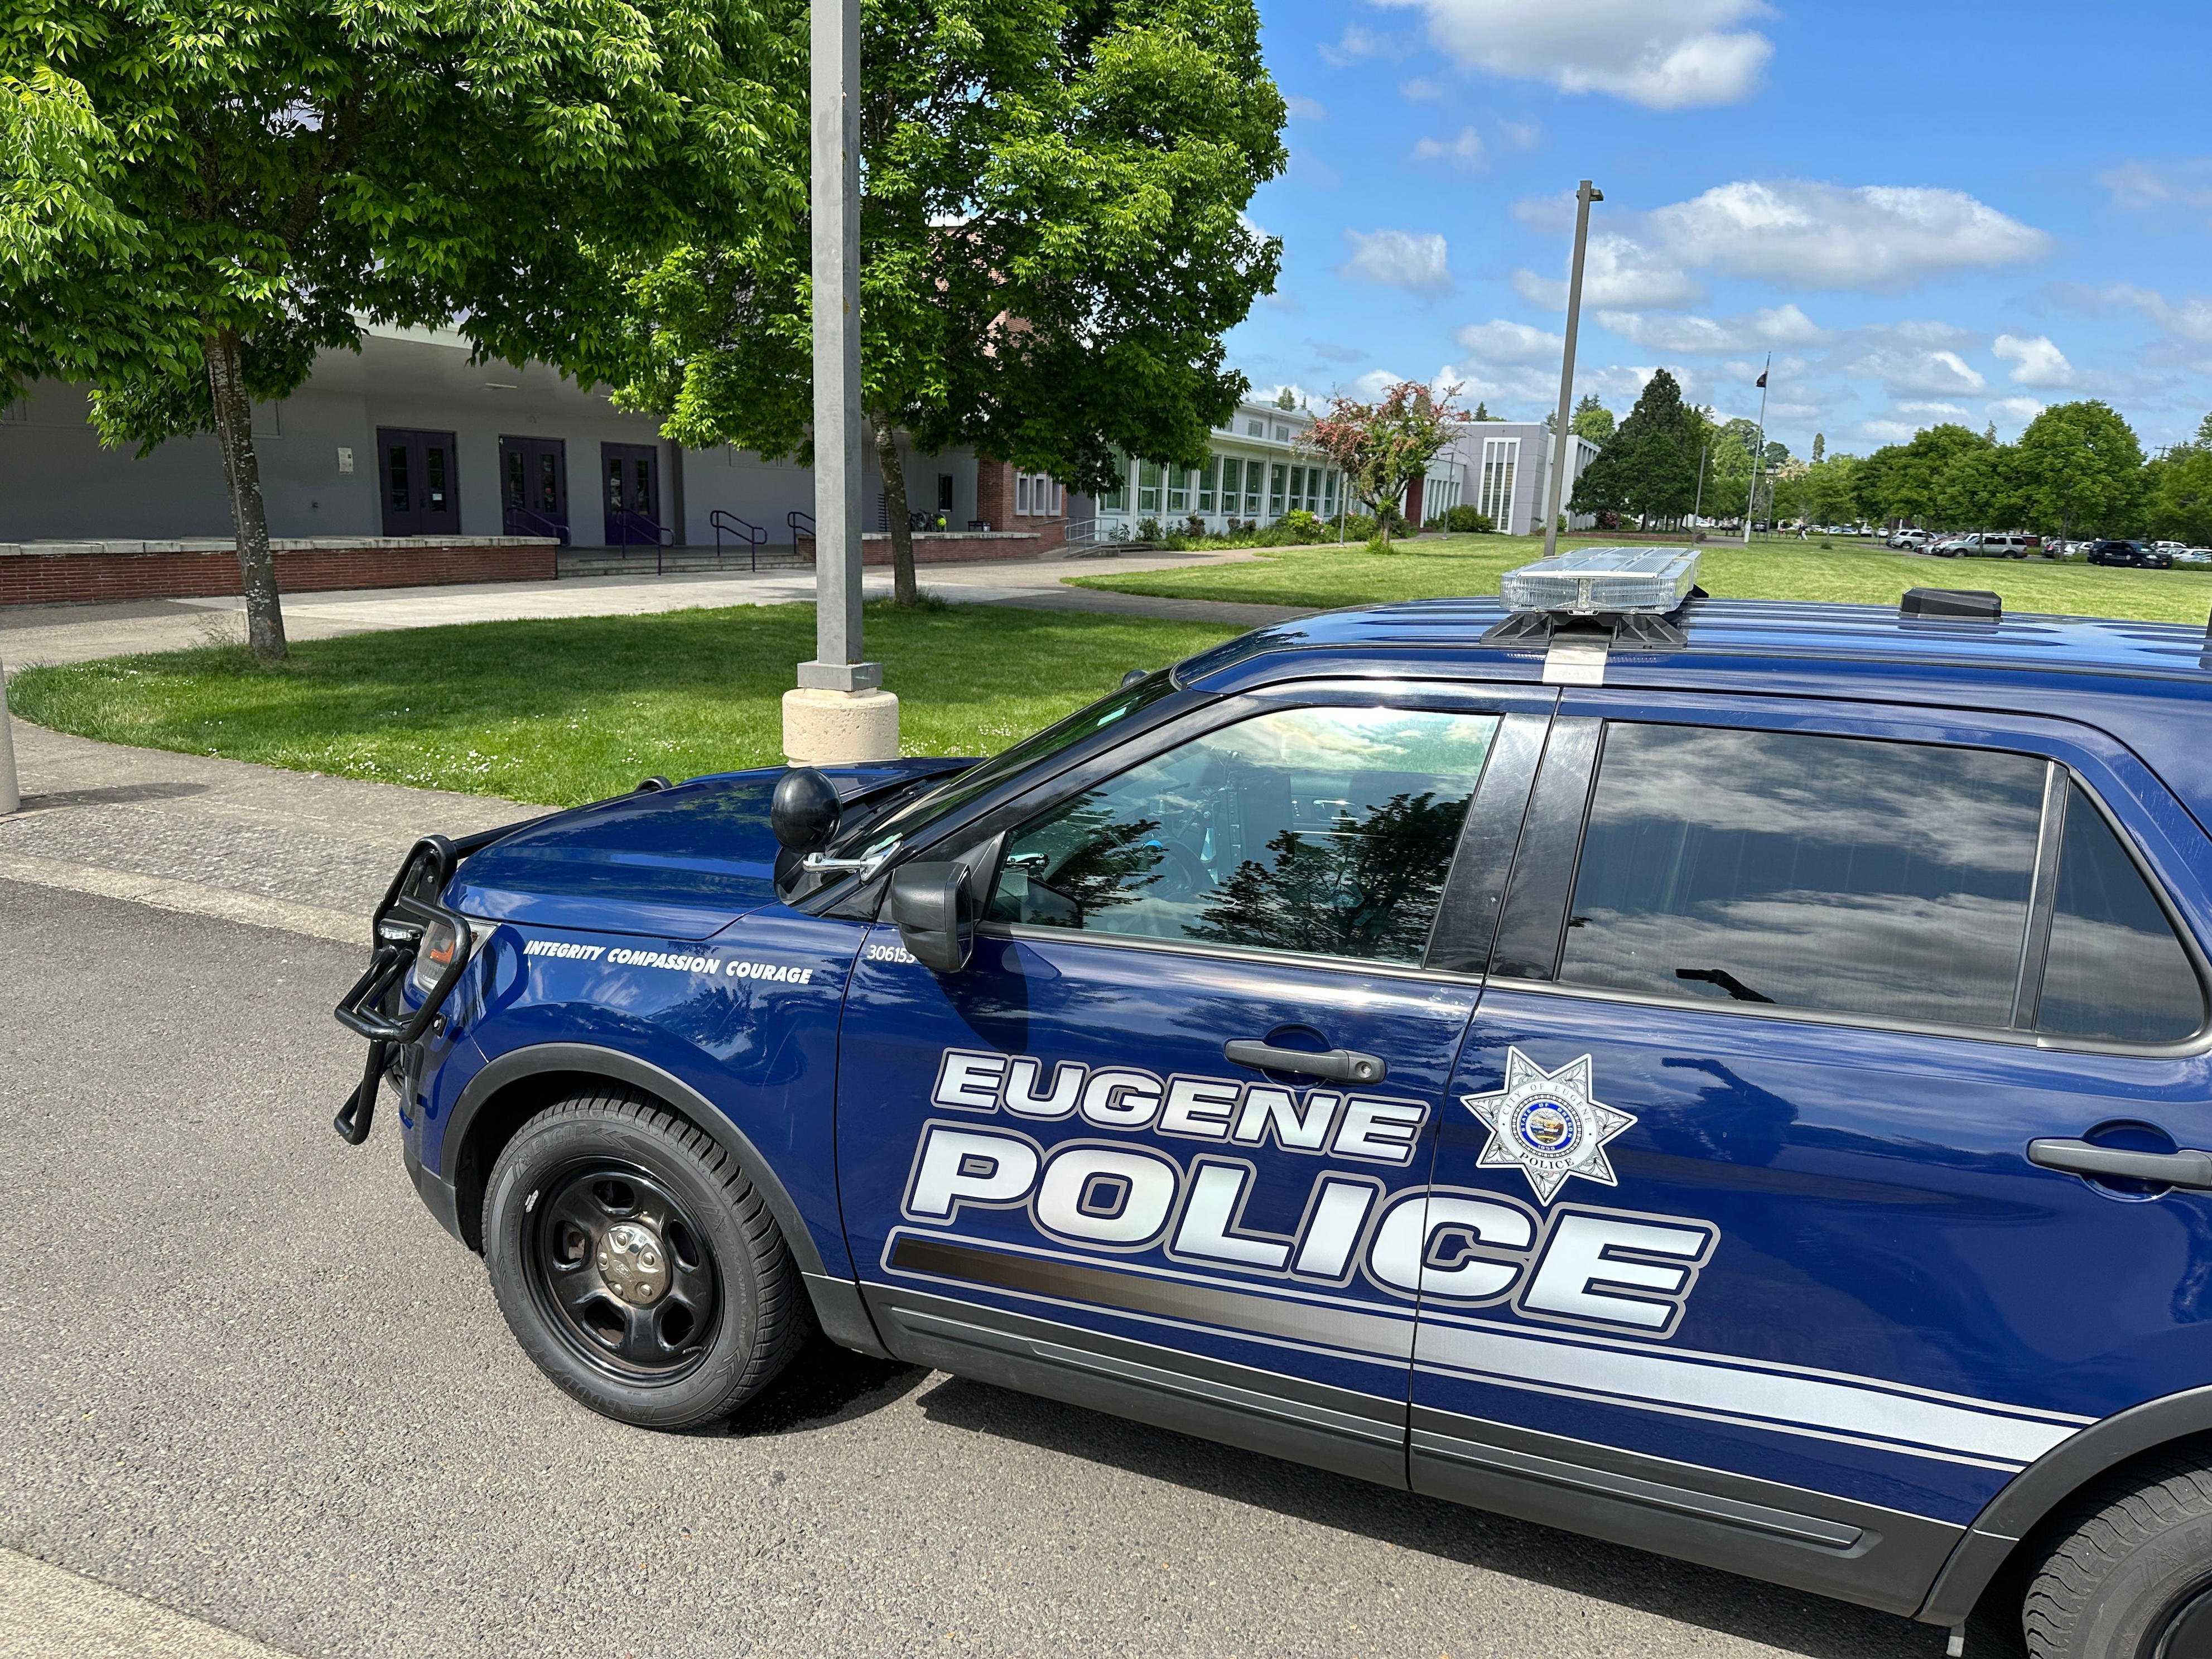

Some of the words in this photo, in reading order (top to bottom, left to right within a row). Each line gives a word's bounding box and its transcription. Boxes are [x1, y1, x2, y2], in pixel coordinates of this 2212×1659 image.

[523, 941, 606, 961] INTEGRITY
[608, 948, 721, 974] COMPASSION
[726, 961, 813, 984] COURAGE
[934, 1051, 1426, 1163] EUGENE
[1502, 1091, 1522, 1115] CITY
[1554, 1085, 1592, 1123] EUGENE
[1520, 1108, 1531, 1132] STATE
[1557, 1107, 1573, 1138] OREGON
[531, 1123, 587, 1156] EAGLE
[1519, 1151, 1574, 1169] POLICE
[907, 1125, 1709, 1331] POLICE
